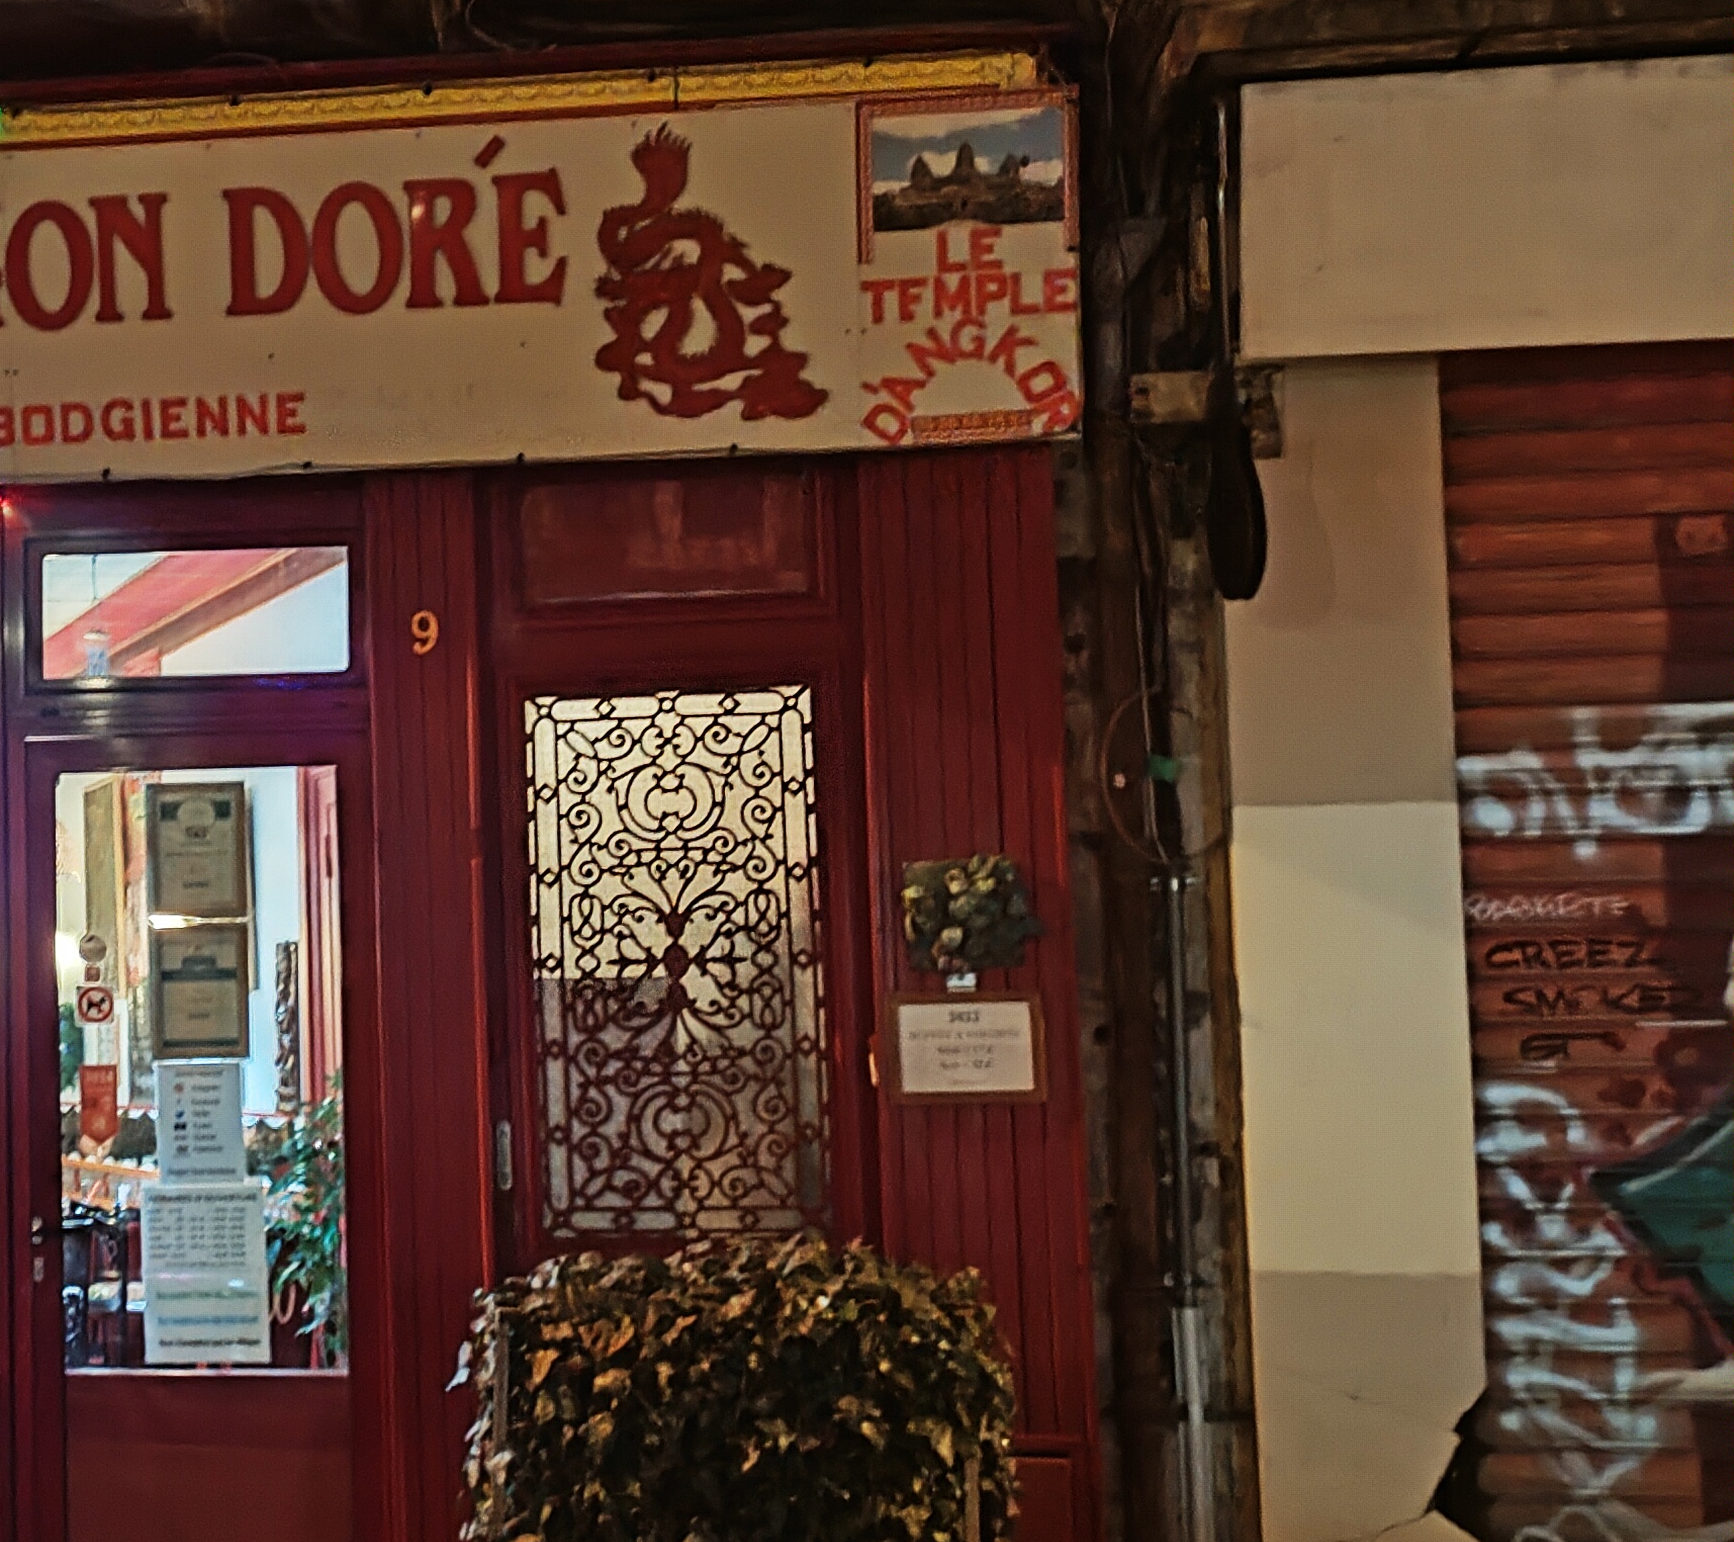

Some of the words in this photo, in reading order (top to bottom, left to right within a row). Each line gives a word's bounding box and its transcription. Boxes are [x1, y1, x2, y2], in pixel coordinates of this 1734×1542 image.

[222, 135, 568, 316] DORÉ
[936, 226, 1003, 274] LE
[860, 267, 1078, 325] TEMPLE
[411, 609, 439, 655] 9
